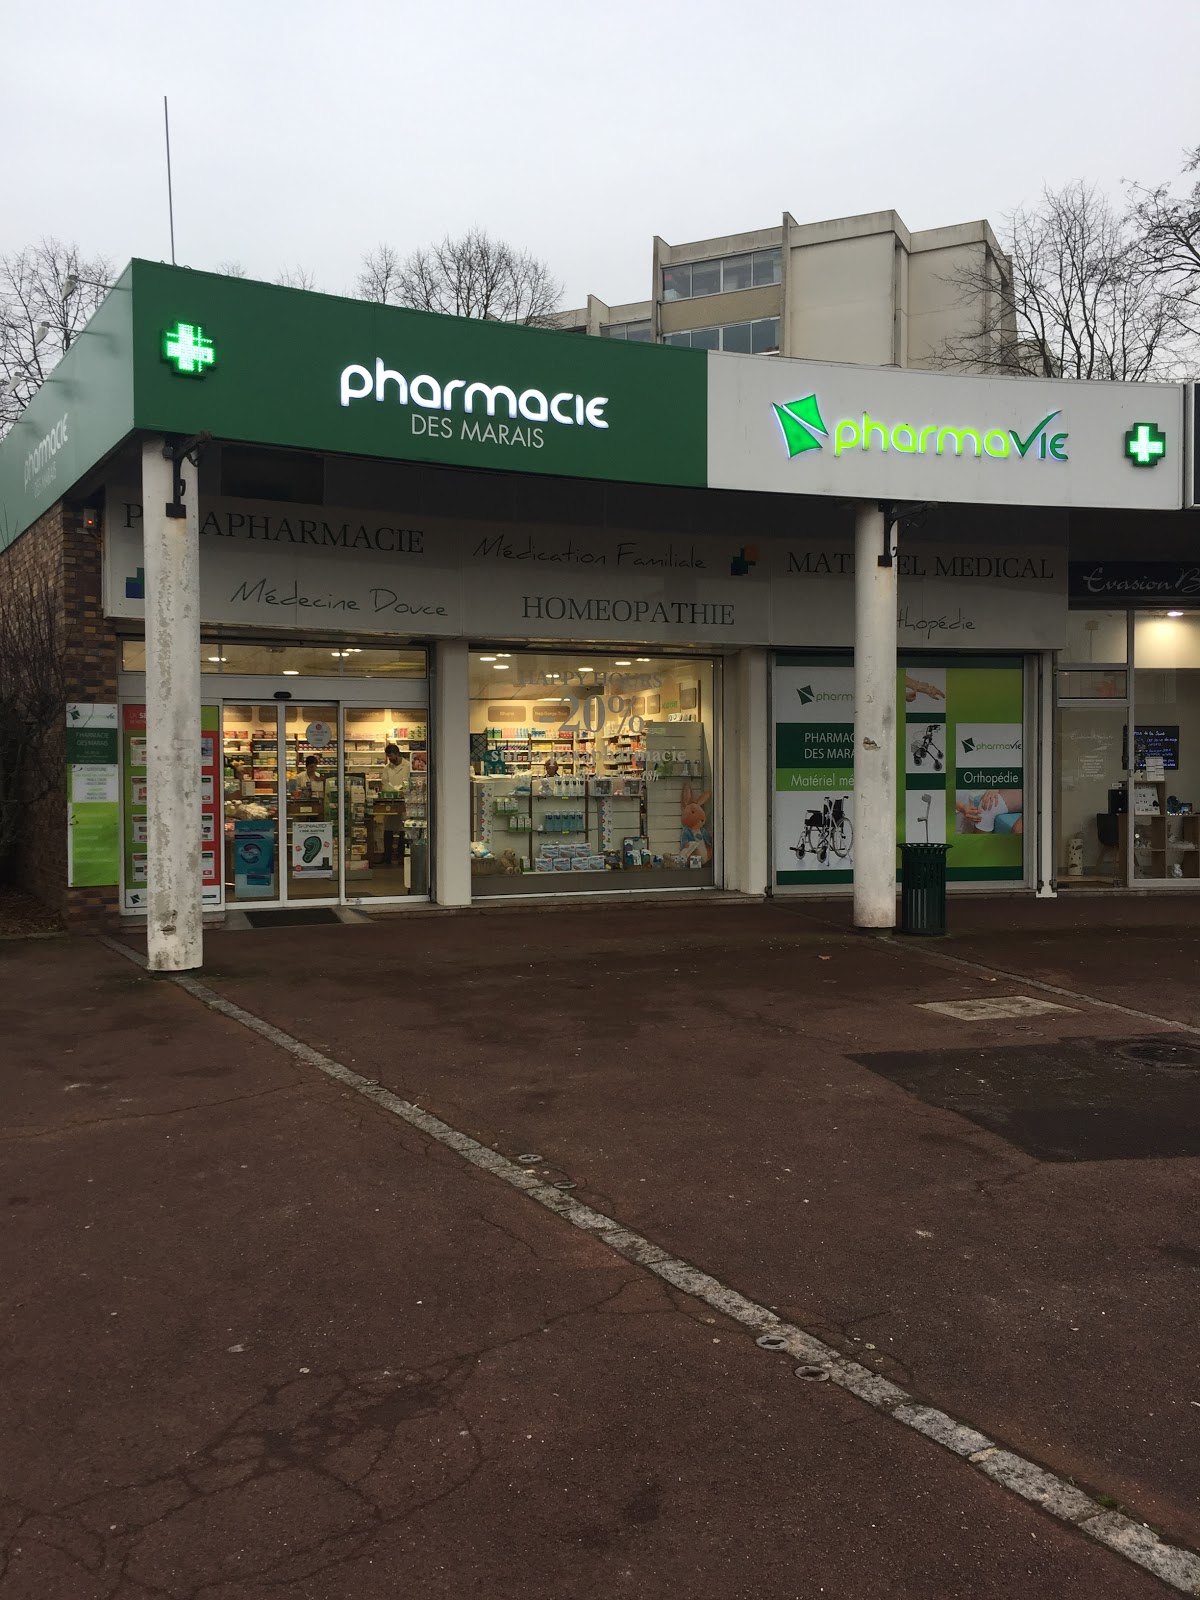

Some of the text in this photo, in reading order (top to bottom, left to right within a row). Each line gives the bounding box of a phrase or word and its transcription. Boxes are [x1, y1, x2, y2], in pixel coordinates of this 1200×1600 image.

[340, 356, 609, 428] pharmacie
[411, 413, 545, 449] DES MARAIS
[122, 502, 425, 554] PAPHARMACIE
[472, 534, 708, 569] Médication Familiale
[786, 551, 1055, 580] MATEL MEDICAL
[229, 577, 449, 617] Médecine Douce
[521, 596, 736, 626] HOMEOPATHIE
[897, 607, 976, 640] thopédie
[518, 671, 664, 688] HAPPY HOURS
[804, 748, 825, 759] DES
[790, 773, 836, 788] Matériel
[963, 771, 1019, 787] Orthopédie
